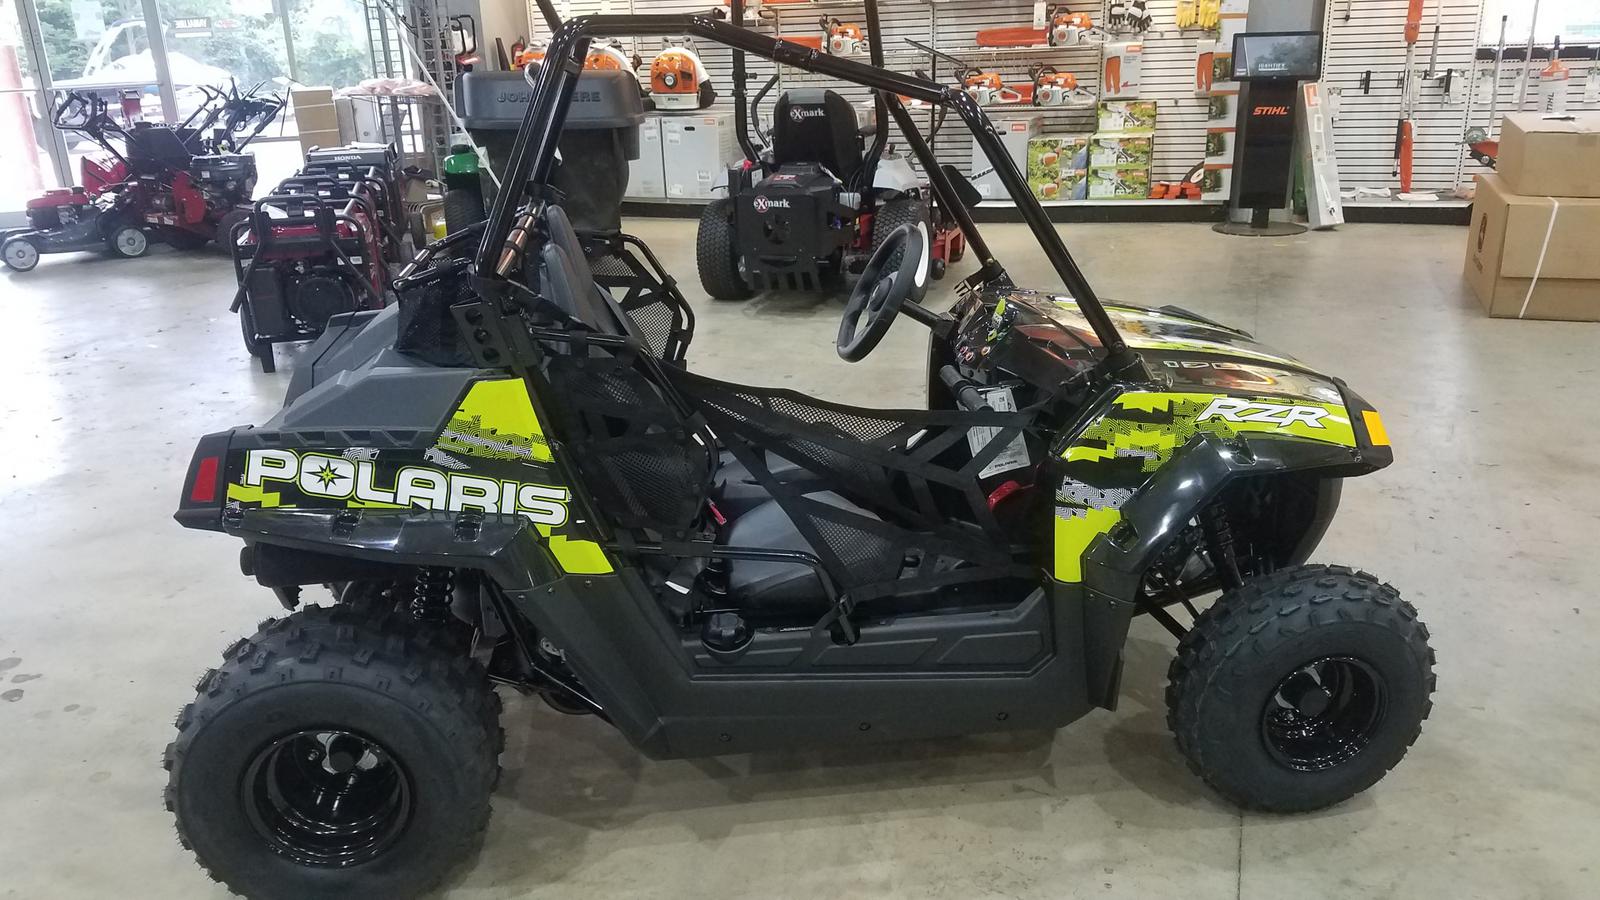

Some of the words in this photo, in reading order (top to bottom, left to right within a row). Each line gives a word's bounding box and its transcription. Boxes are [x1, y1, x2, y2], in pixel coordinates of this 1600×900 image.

[1253, 106, 1289, 116] STIHL
[1195, 398, 1331, 429] RZR
[245, 447, 569, 526] POLARIS
